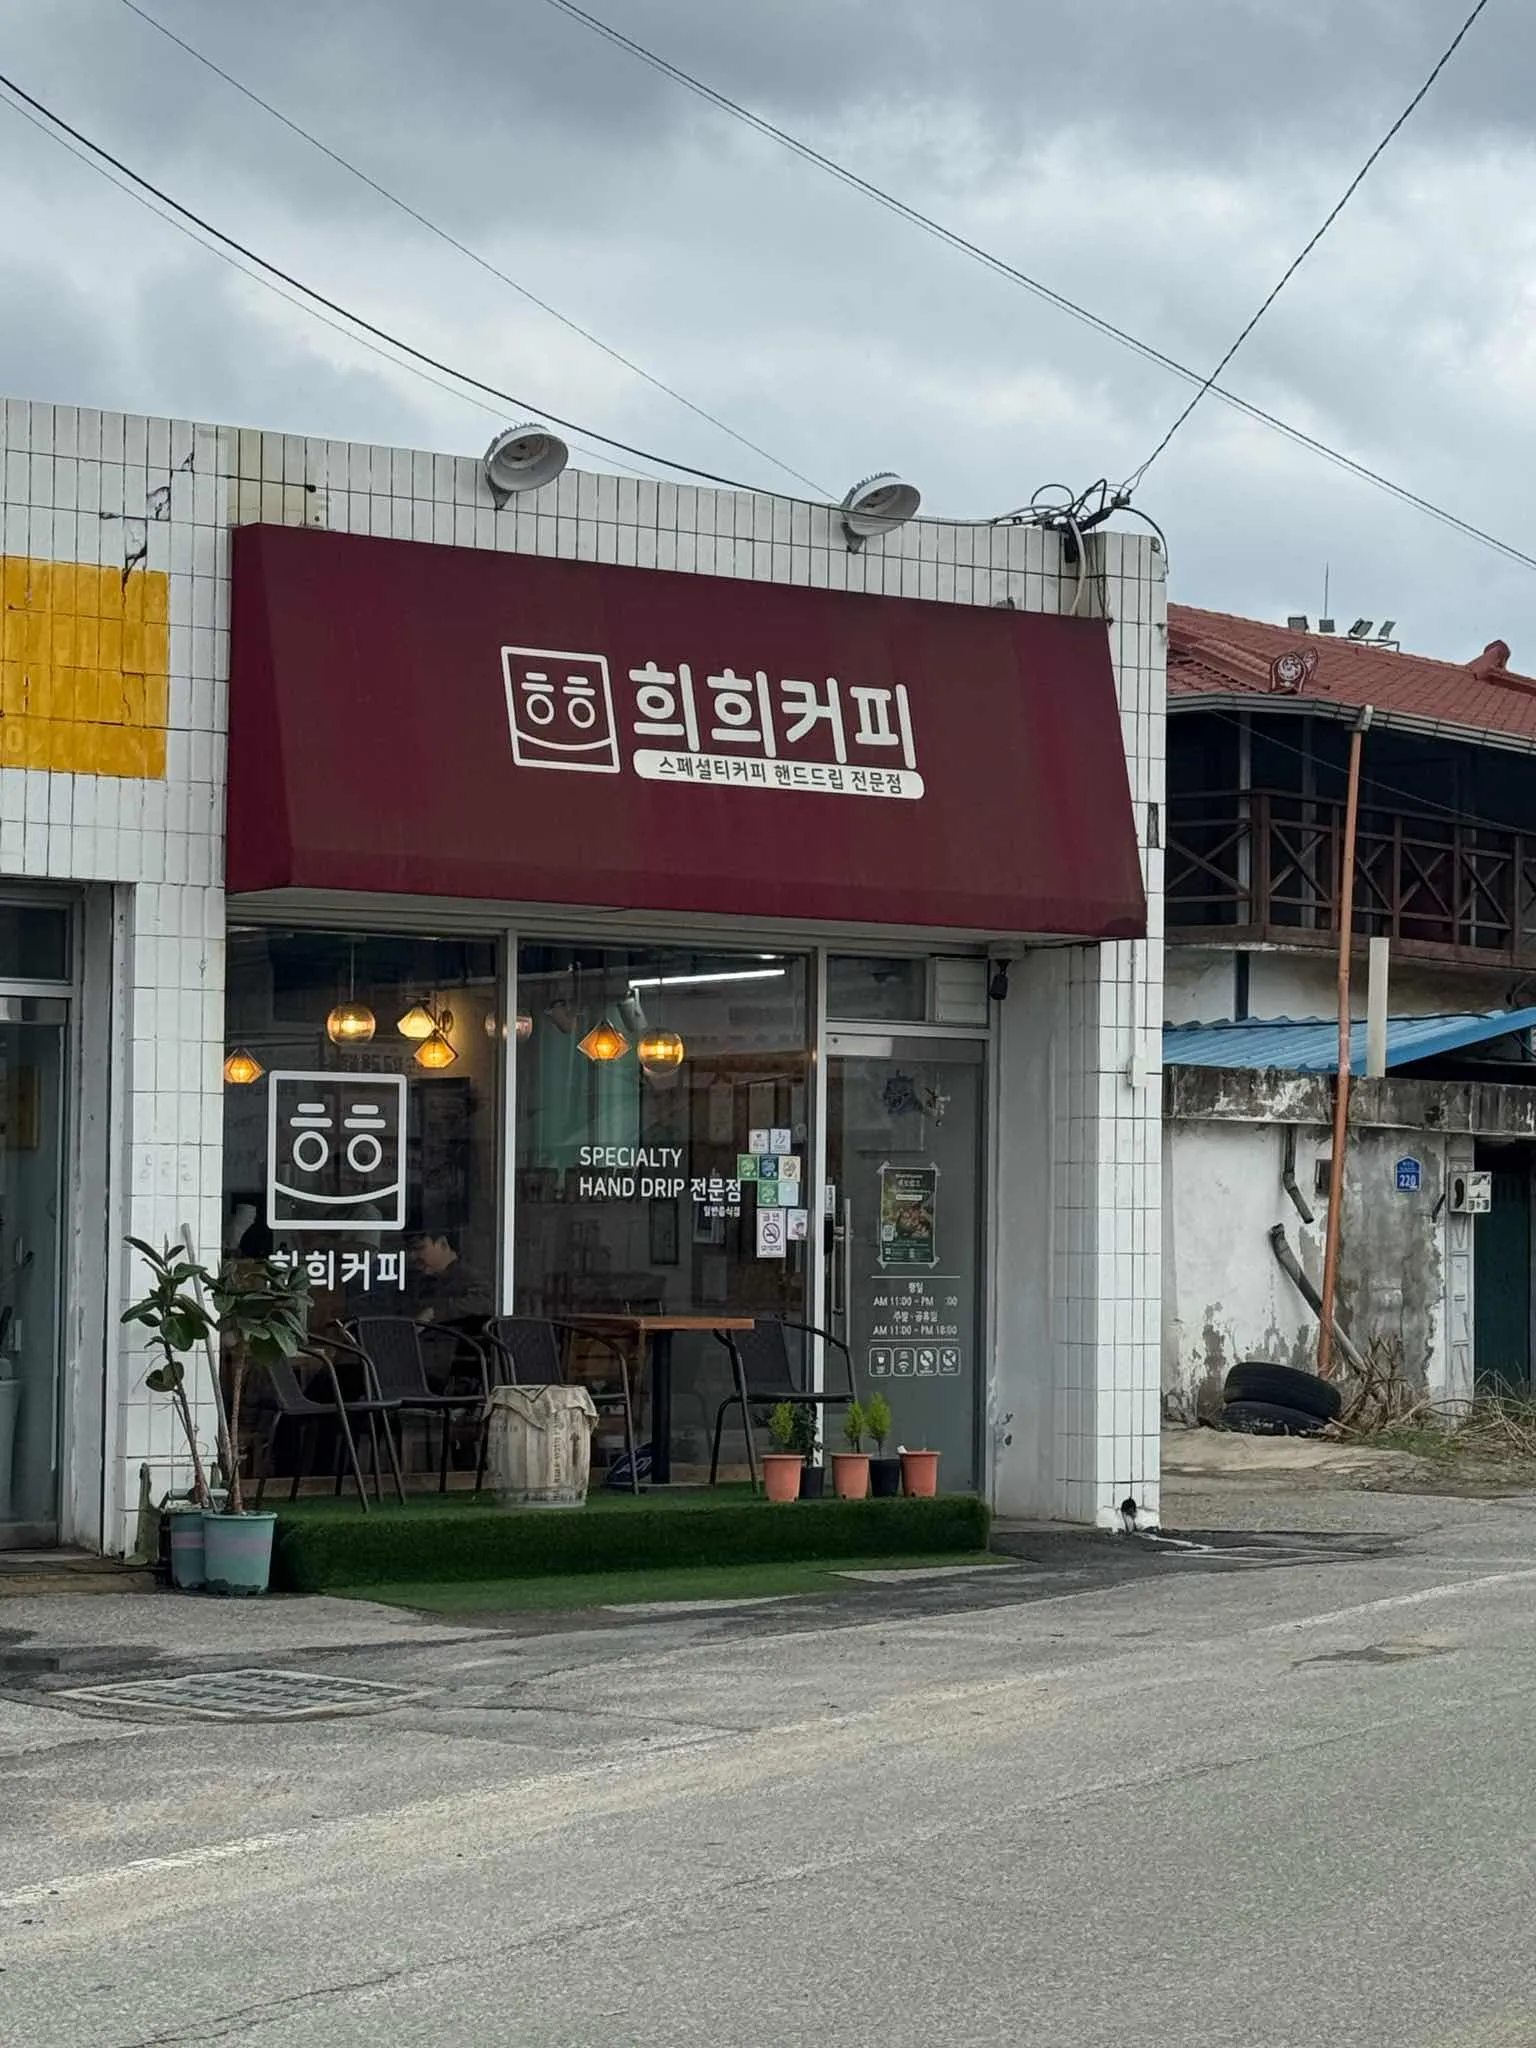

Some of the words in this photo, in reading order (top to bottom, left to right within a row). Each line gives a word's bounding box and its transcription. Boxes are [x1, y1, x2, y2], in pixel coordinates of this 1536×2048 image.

[629, 661, 917, 769] 희희커피
[658, 755, 767, 784] 스페셜티커피
[774, 763, 845, 790] 핸드드립
[851, 771, 903, 795] 전문점
[579, 1145, 684, 1168] SPECIALTY
[1399, 1174, 1417, 1187] 220
[579, 1177, 636, 1198] HAND
[640, 1178, 685, 1199] DRIP
[689, 1178, 742, 1203] 전문점
[703, 1205, 741, 1218] 일반음식점
[907, 1281, 924, 1295] 평일
[873, 1296, 889, 1307] AM
[890, 1296, 912, 1307] 11:00
[921, 1296, 934, 1307] PM
[873, 1325, 888, 1336] AM
[890, 1325, 912, 1336] 11:00
[920, 1325, 934, 1336] PM
